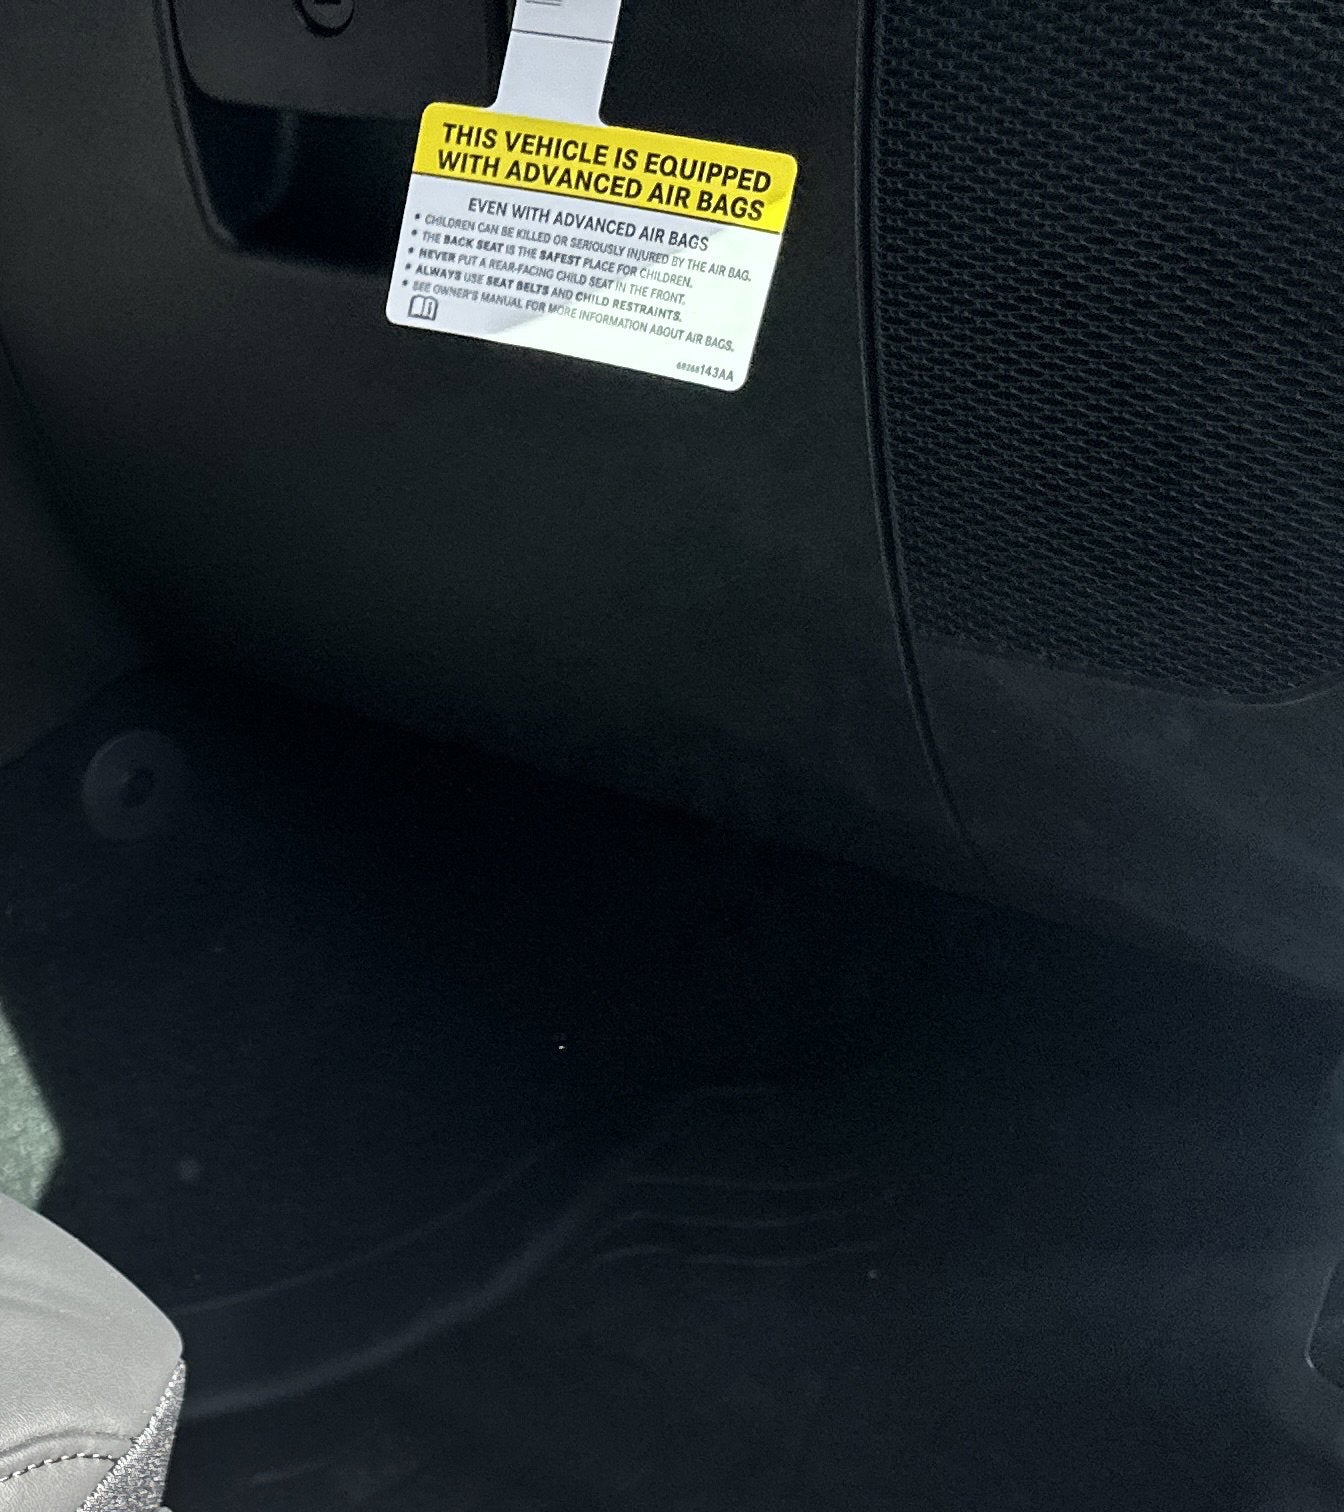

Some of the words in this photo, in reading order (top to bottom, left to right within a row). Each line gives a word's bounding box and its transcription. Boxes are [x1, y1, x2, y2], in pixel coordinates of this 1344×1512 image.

[438, 149, 501, 177] WITH
[505, 159, 642, 199] ADVANCED
[647, 182, 691, 209] AIR
[696, 190, 765, 221] BAGS
[443, 122, 498, 149] THIS
[505, 131, 609, 166] VEHICLE
[614, 147, 639, 171] IS
[644, 152, 771, 193] EQUIPPED
[424, 214, 475, 231] CHILDREN
[478, 222, 499, 234] CAN
[501, 226, 514, 238] BE
[516, 228, 550, 243] KILLED
[553, 234, 569, 247] OR
[570, 237, 625, 257] SERIOUSLY
[627, 247, 669, 265] INJURED
[672, 256, 685, 267] BY
[687, 259, 707, 272] THE
[708, 263, 726, 276] AIR
[728, 267, 751, 282] BAG.
[468, 198, 508, 216] EVEN
[512, 204, 551, 223] WITH
[553, 211, 636, 237] ADVANCED
[639, 226, 665, 243] AIR
[668, 231, 709, 251] BAGS
[419, 248, 456, 262] NEVER
[458, 254, 478, 266] PUT
[479, 258, 487, 268] A
[489, 259, 554, 279] REAR-FACING
[556, 272, 587, 286] CHILD
[589, 275, 614, 289] SEAT
[615, 281, 627, 292] IN
[629, 283, 648, 297] THE
[650, 288, 686, 305] FRONT.
[422, 231, 441, 243] THE
[444, 234, 474, 248] BACK
[476, 240, 504, 252] SEAT
[506, 244, 515, 255] IS
[518, 246, 537, 259] THE
[539, 250, 581, 266] SAFEST
[582, 257, 615, 272] PLACE
[617, 263, 638, 276] FOR
[640, 267, 692, 288] CHILDREN.
[412, 280, 431, 292] SEE
[433, 284, 479, 300] OWNER'S
[480, 292, 523, 309] MANUAL
[526, 300, 547, 313] FOR
[548, 304, 576, 319] MORE
[579, 309, 648, 332] INFORMATION
[649, 324, 685, 340] ABOUT
[685, 331, 703, 345] AIR
[705, 335, 734, 352] BAGS.
[415, 264, 462, 281] ALWAYS
[463, 272, 484, 284] USE
[486, 276, 514, 289] SEAT
[516, 281, 549, 295] BELTS
[551, 288, 574, 300] AND
[575, 291, 609, 306] CHILD
[612, 299, 682, 322] RESTRAINTS.
